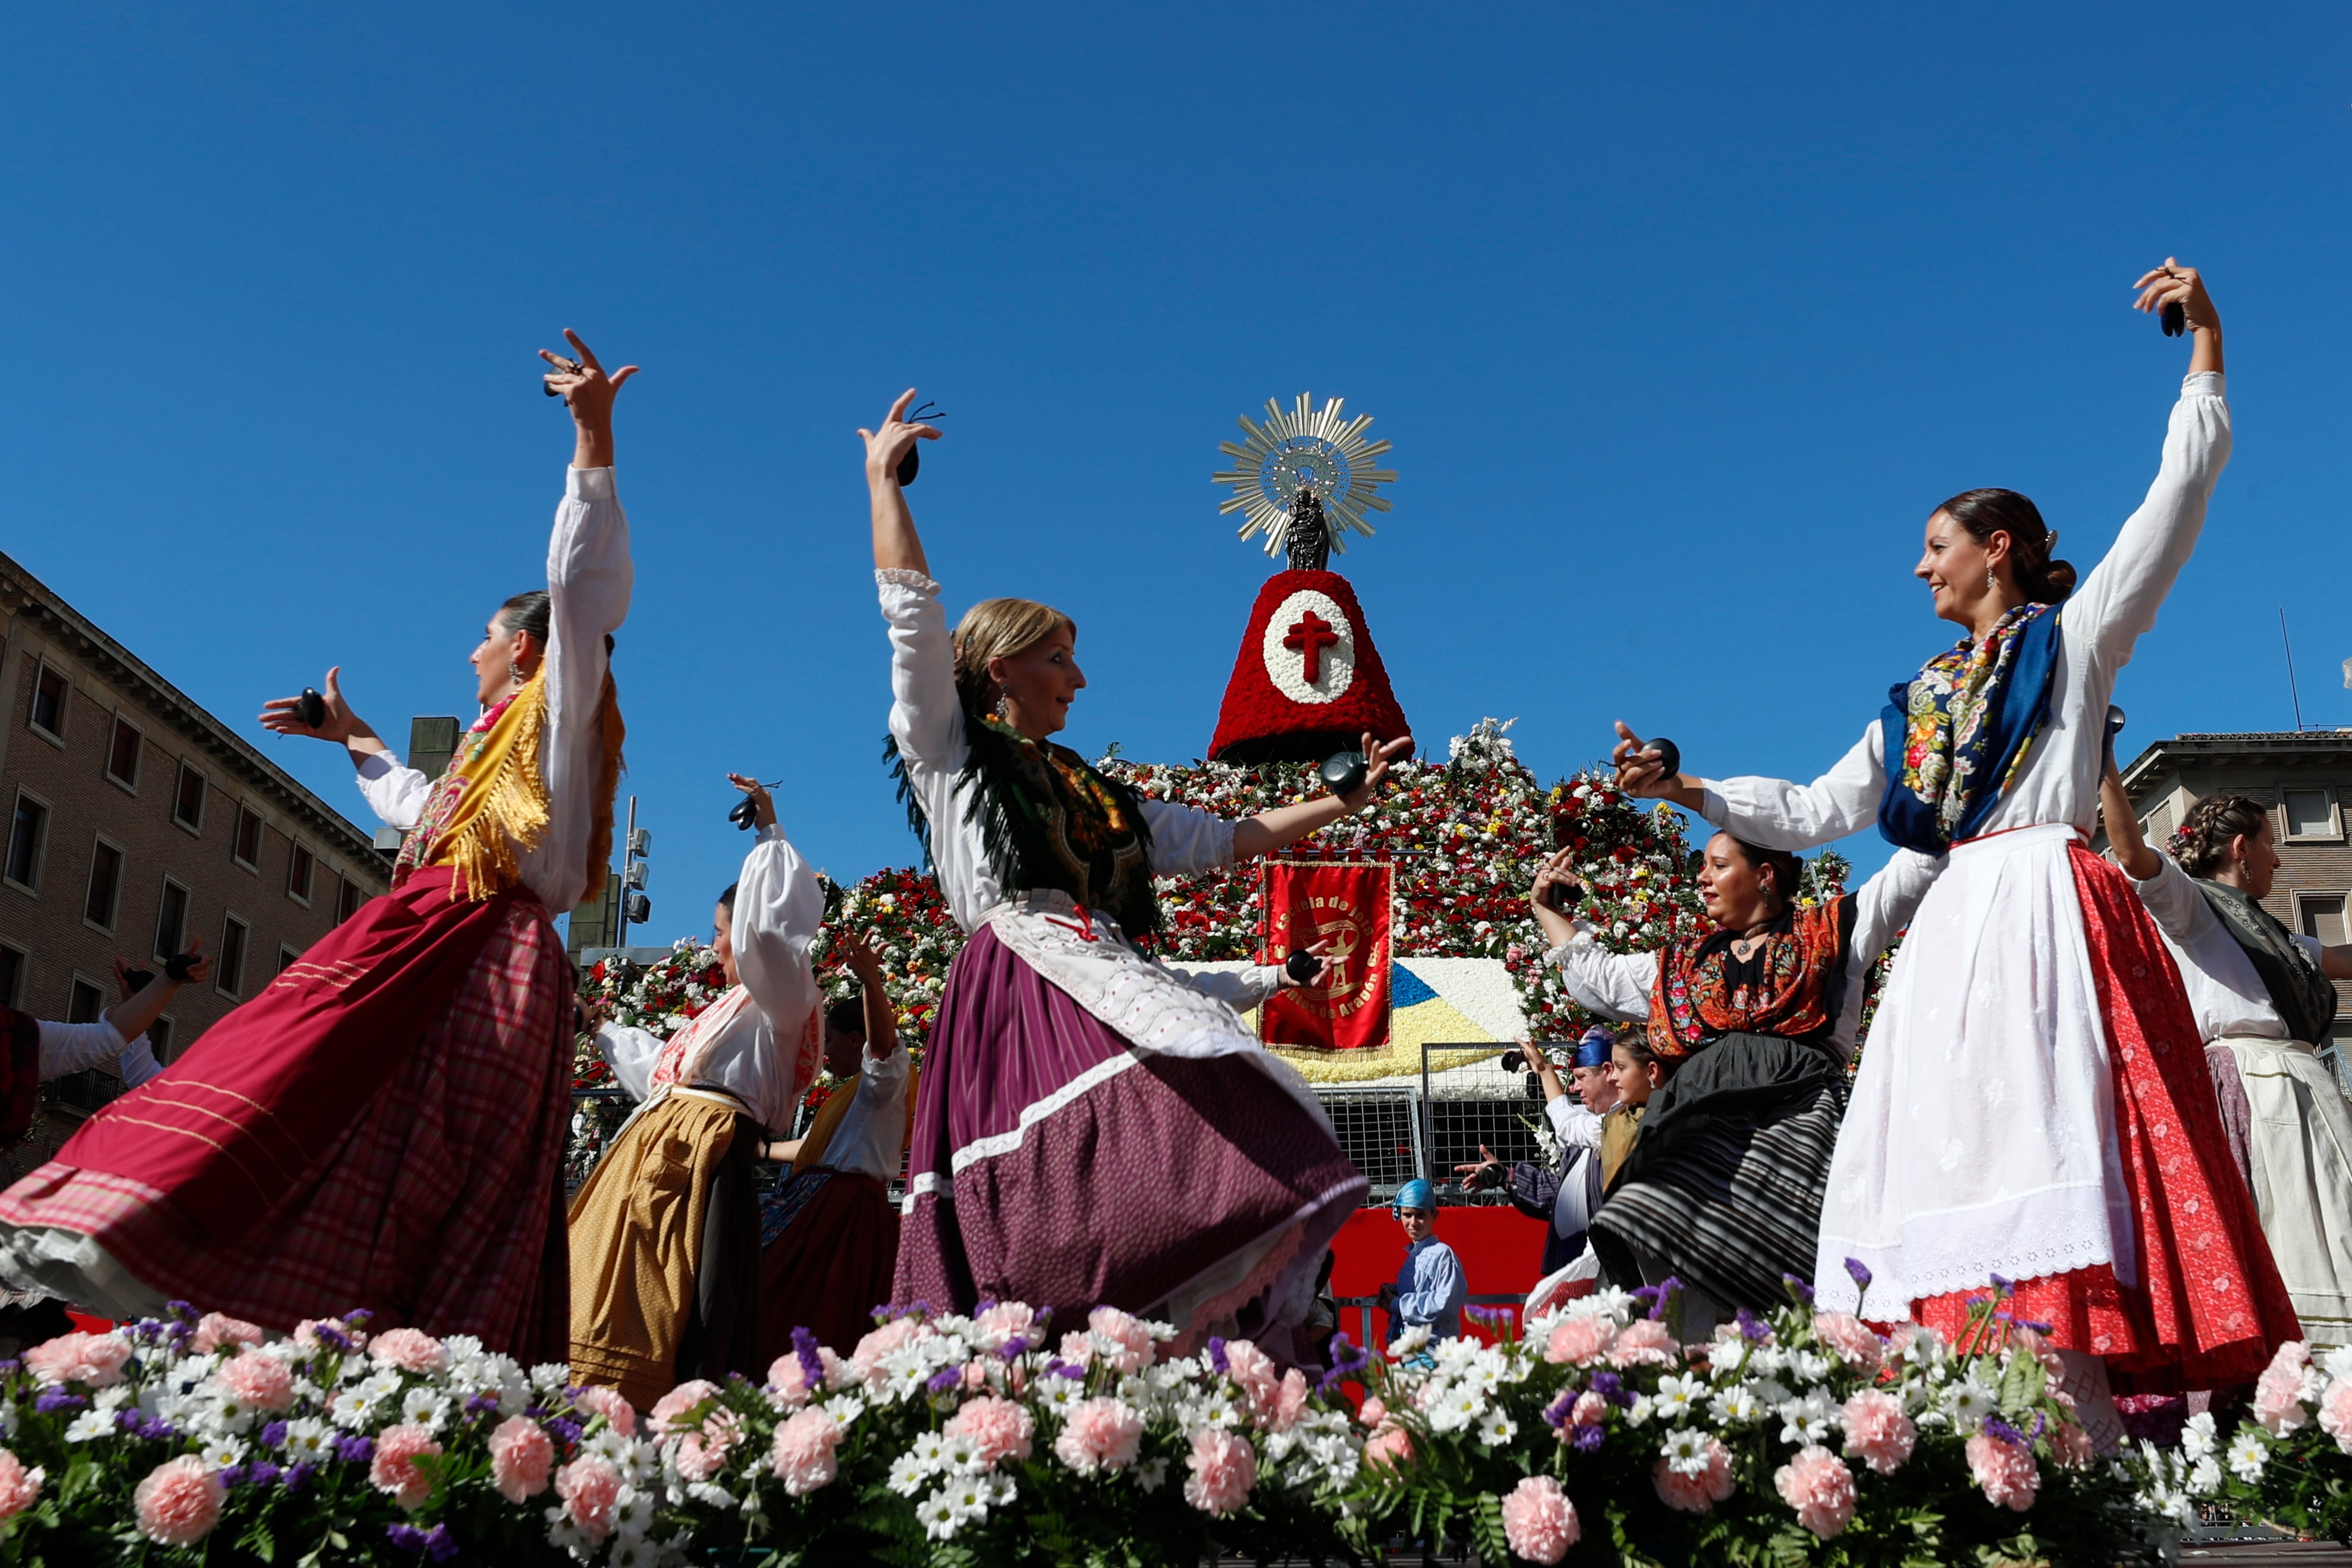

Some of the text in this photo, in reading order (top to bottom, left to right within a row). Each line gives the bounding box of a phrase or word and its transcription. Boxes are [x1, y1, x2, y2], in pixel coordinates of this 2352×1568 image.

[1275, 896, 1324, 931] Escuela
[1329, 895, 1349, 911] de
[1320, 1007, 1336, 1019] de
[1339, 973, 1378, 1017] Aragón
